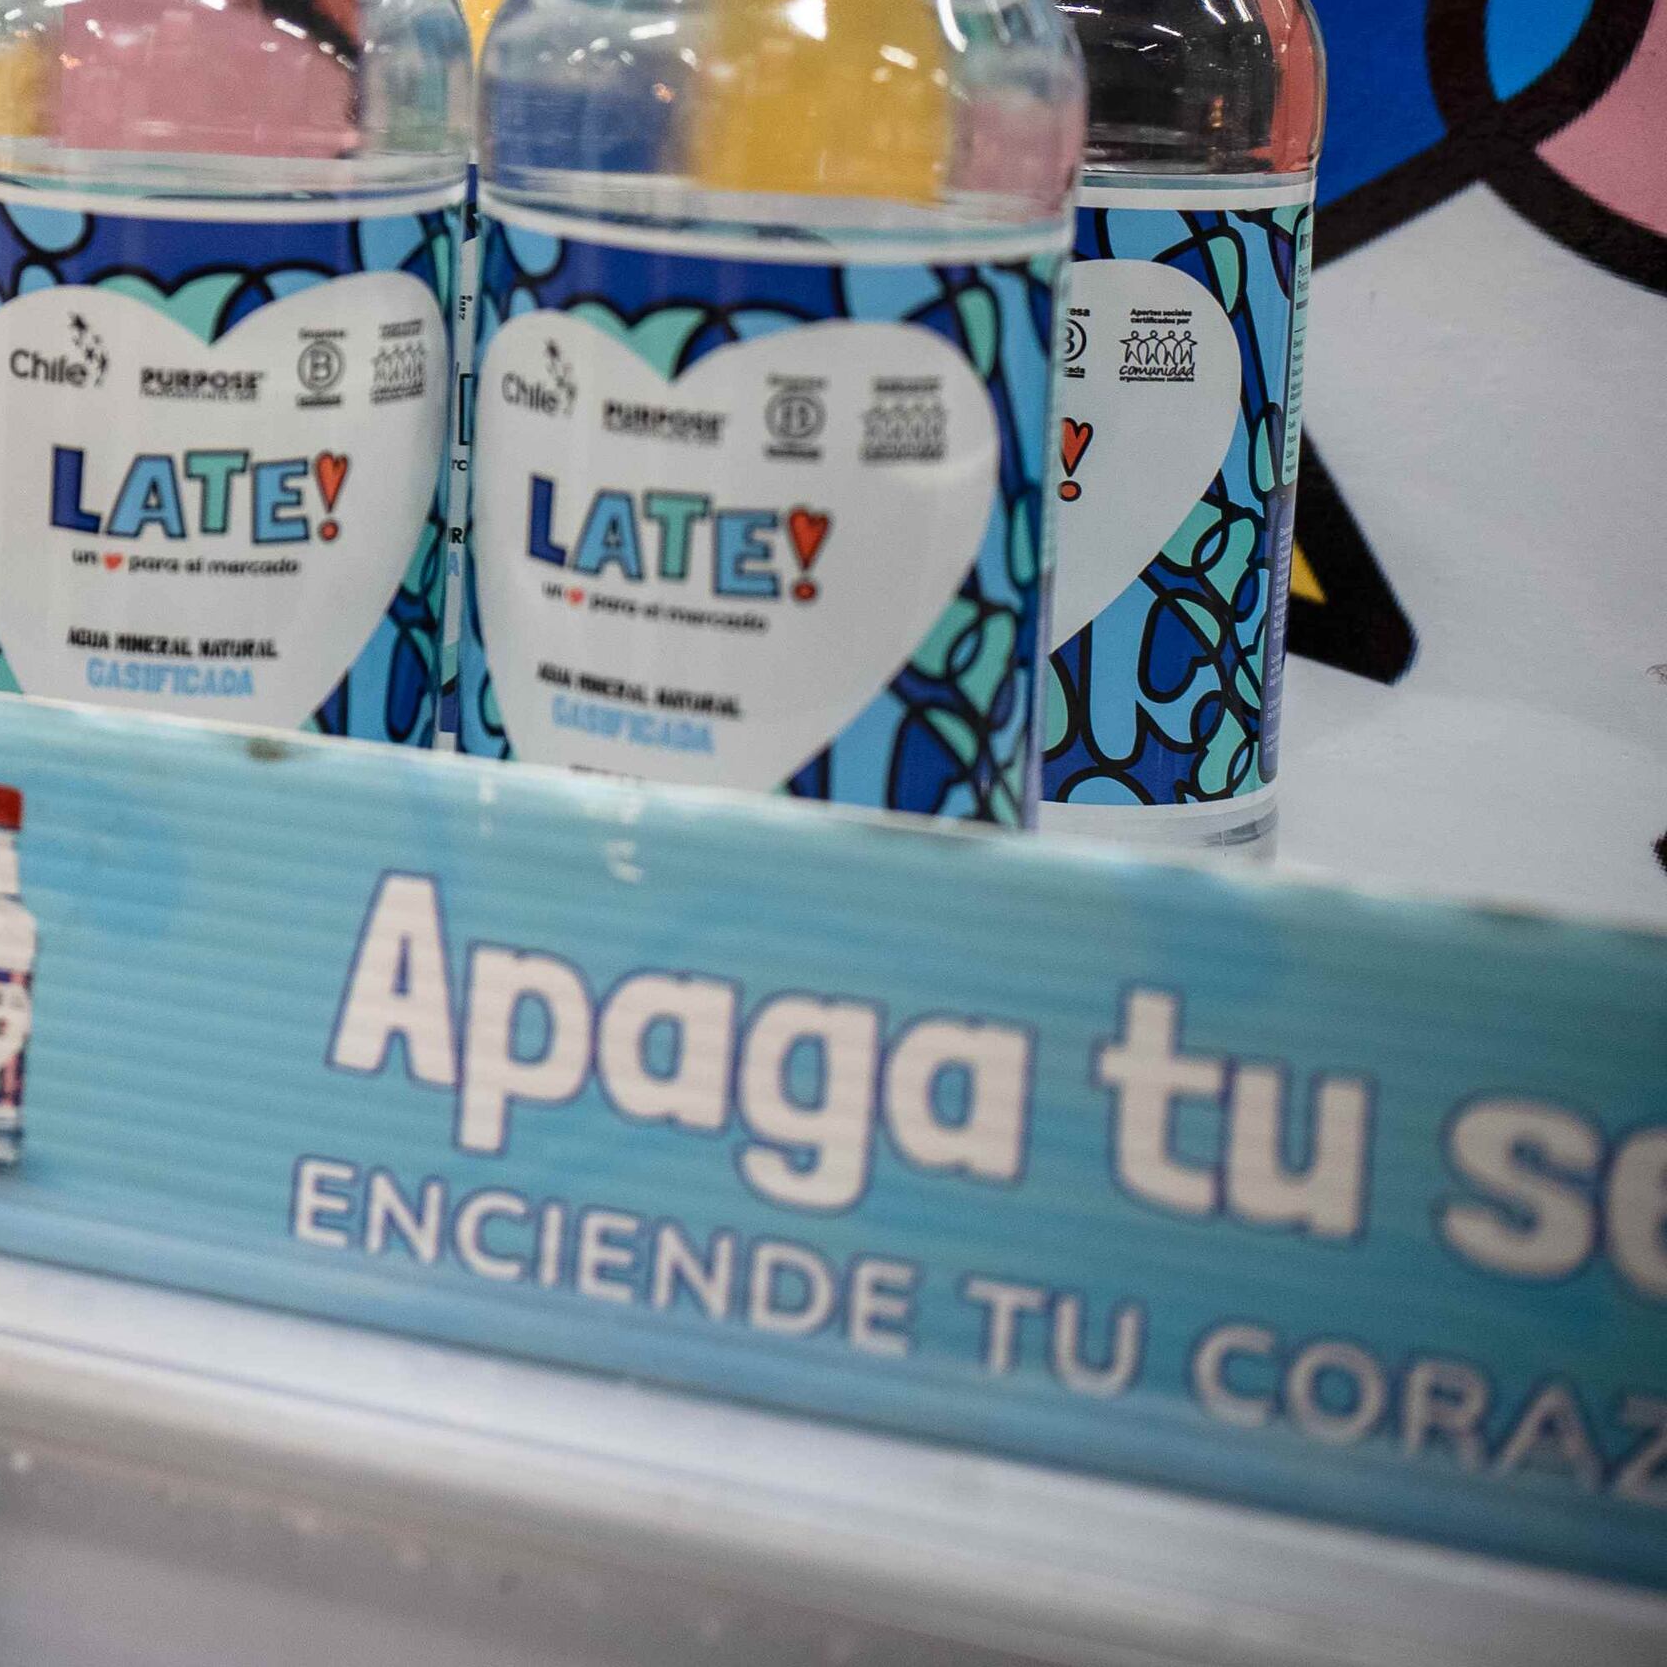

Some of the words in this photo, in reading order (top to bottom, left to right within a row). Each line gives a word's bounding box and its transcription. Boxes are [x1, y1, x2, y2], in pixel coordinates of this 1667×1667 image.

[9, 349, 88, 388] Chile
[1119, 362, 1196, 376] comunidad
[51, 444, 349, 545] LATE!
[527, 472, 831, 602] LATE!
[67, 626, 110, 650] AGUA
[325, 869, 1036, 1211] Apaga
[1095, 987, 1375, 1241] tu
[291, 1156, 920, 1358] ENCIENDE
[965, 1279, 1145, 1397] TU
